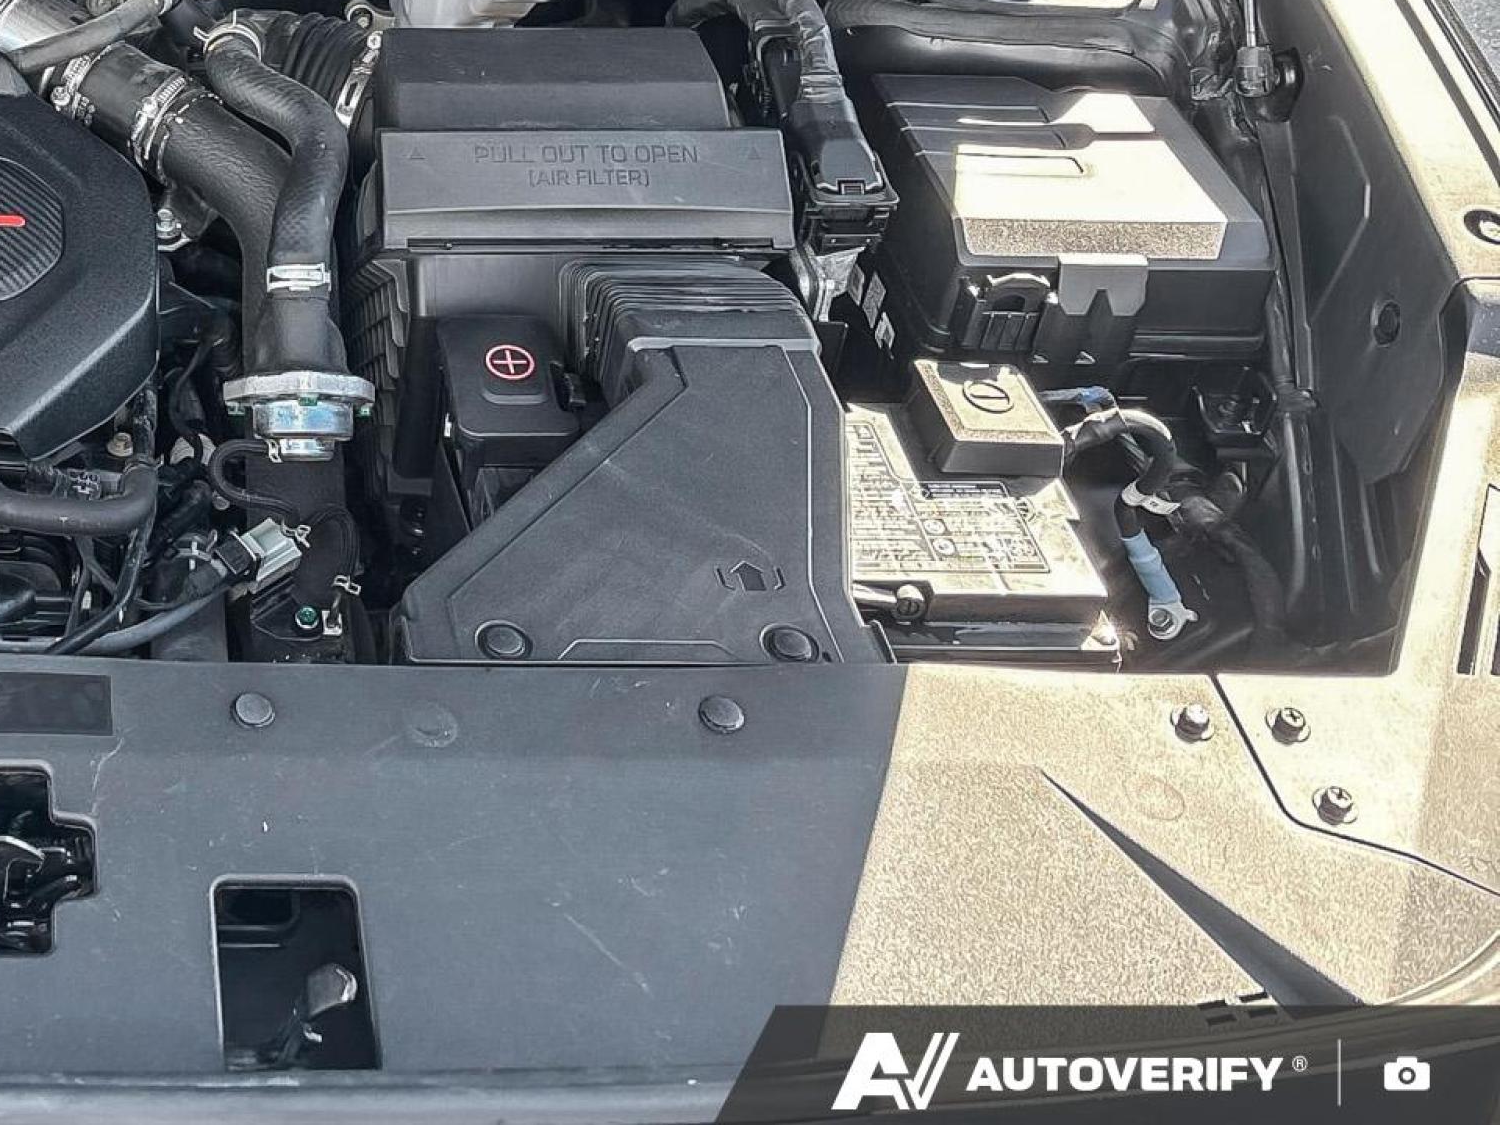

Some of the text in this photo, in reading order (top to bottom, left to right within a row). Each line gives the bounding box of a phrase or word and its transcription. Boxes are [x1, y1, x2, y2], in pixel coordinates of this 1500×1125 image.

[474, 144, 699, 163] PULL OUT TO OPEN
